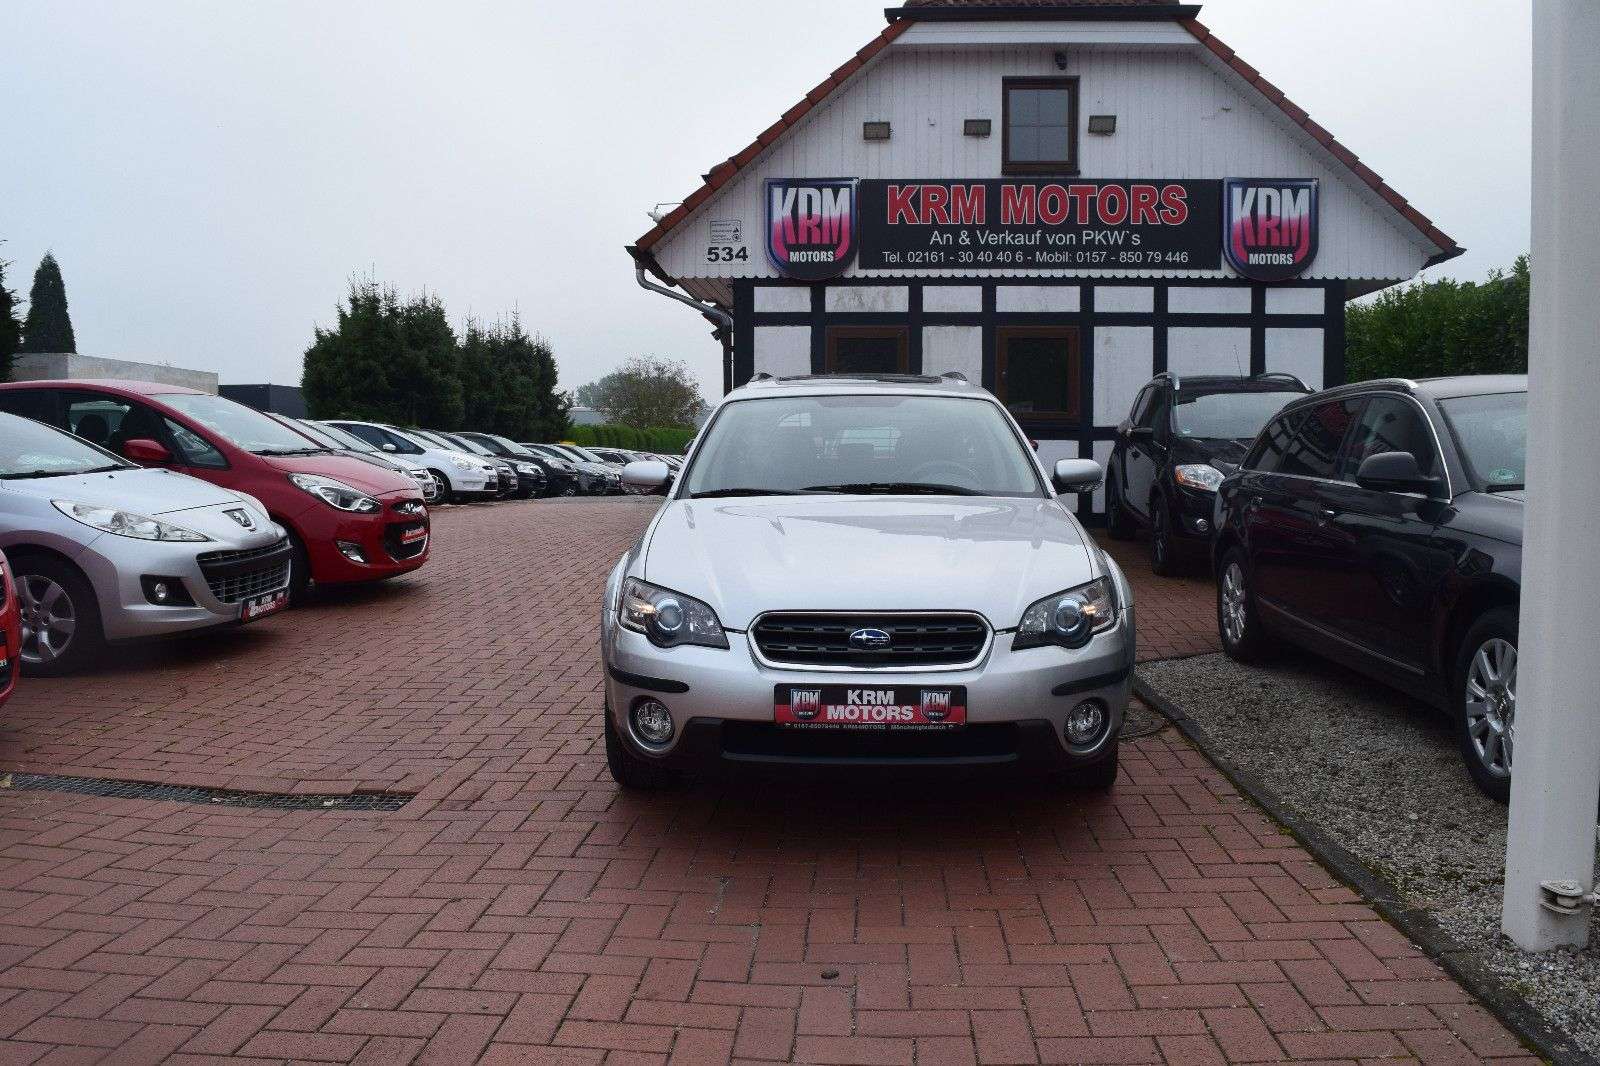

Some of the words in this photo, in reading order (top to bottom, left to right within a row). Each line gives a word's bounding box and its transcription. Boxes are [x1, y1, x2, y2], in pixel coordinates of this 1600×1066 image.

[887, 184, 986, 225] KRM
[1001, 184, 1189, 226] MOTORS
[929, 230, 953, 245] An
[958, 230, 971, 245] &
[976, 229, 1042, 245] Verkauf
[1046, 234, 1076, 245] von
[707, 246, 748, 262] 534
[789, 251, 835, 263] MOTORS
[882, 251, 903, 263] Tel.
[907, 251, 945, 263] 02161
[958, 251, 974, 263] 30
[977, 251, 993, 263] 40
[996, 251, 1012, 263] 40
[1015, 251, 1024, 263] 6
[1035, 251, 1072, 263] Mobil:
[1076, 251, 1107, 263] 0157
[1119, 251, 1143, 263] 850
[1147, 251, 1162, 263] 79
[1165, 251, 1189, 263] 446
[1249, 253, 1293, 265] MOTORS
[847, 689, 895, 705] KRM
[827, 705, 914, 720] MOTORS
